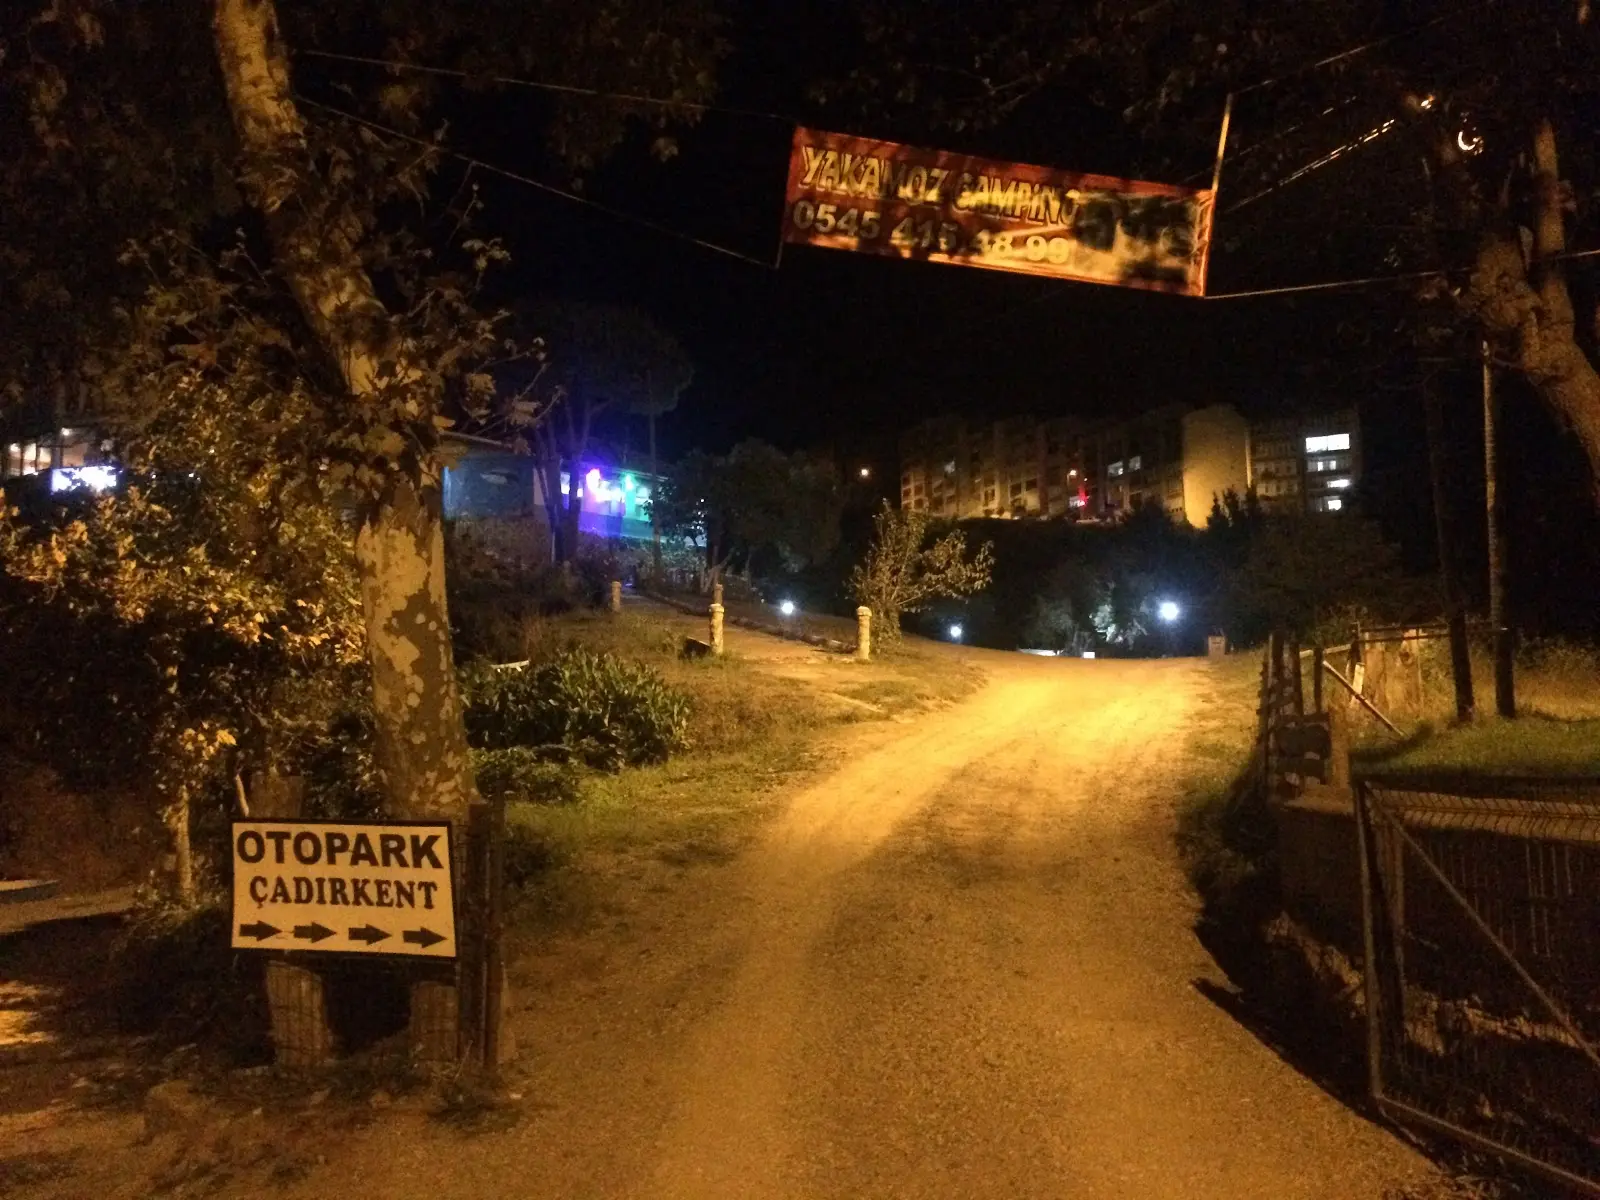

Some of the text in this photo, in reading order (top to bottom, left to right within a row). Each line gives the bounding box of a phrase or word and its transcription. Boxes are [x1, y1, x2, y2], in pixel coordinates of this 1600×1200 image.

[792, 200, 881, 239] 0545
[236, 830, 445, 869] OTOPARK
[249, 874, 438, 910] ÇADIRKENT
